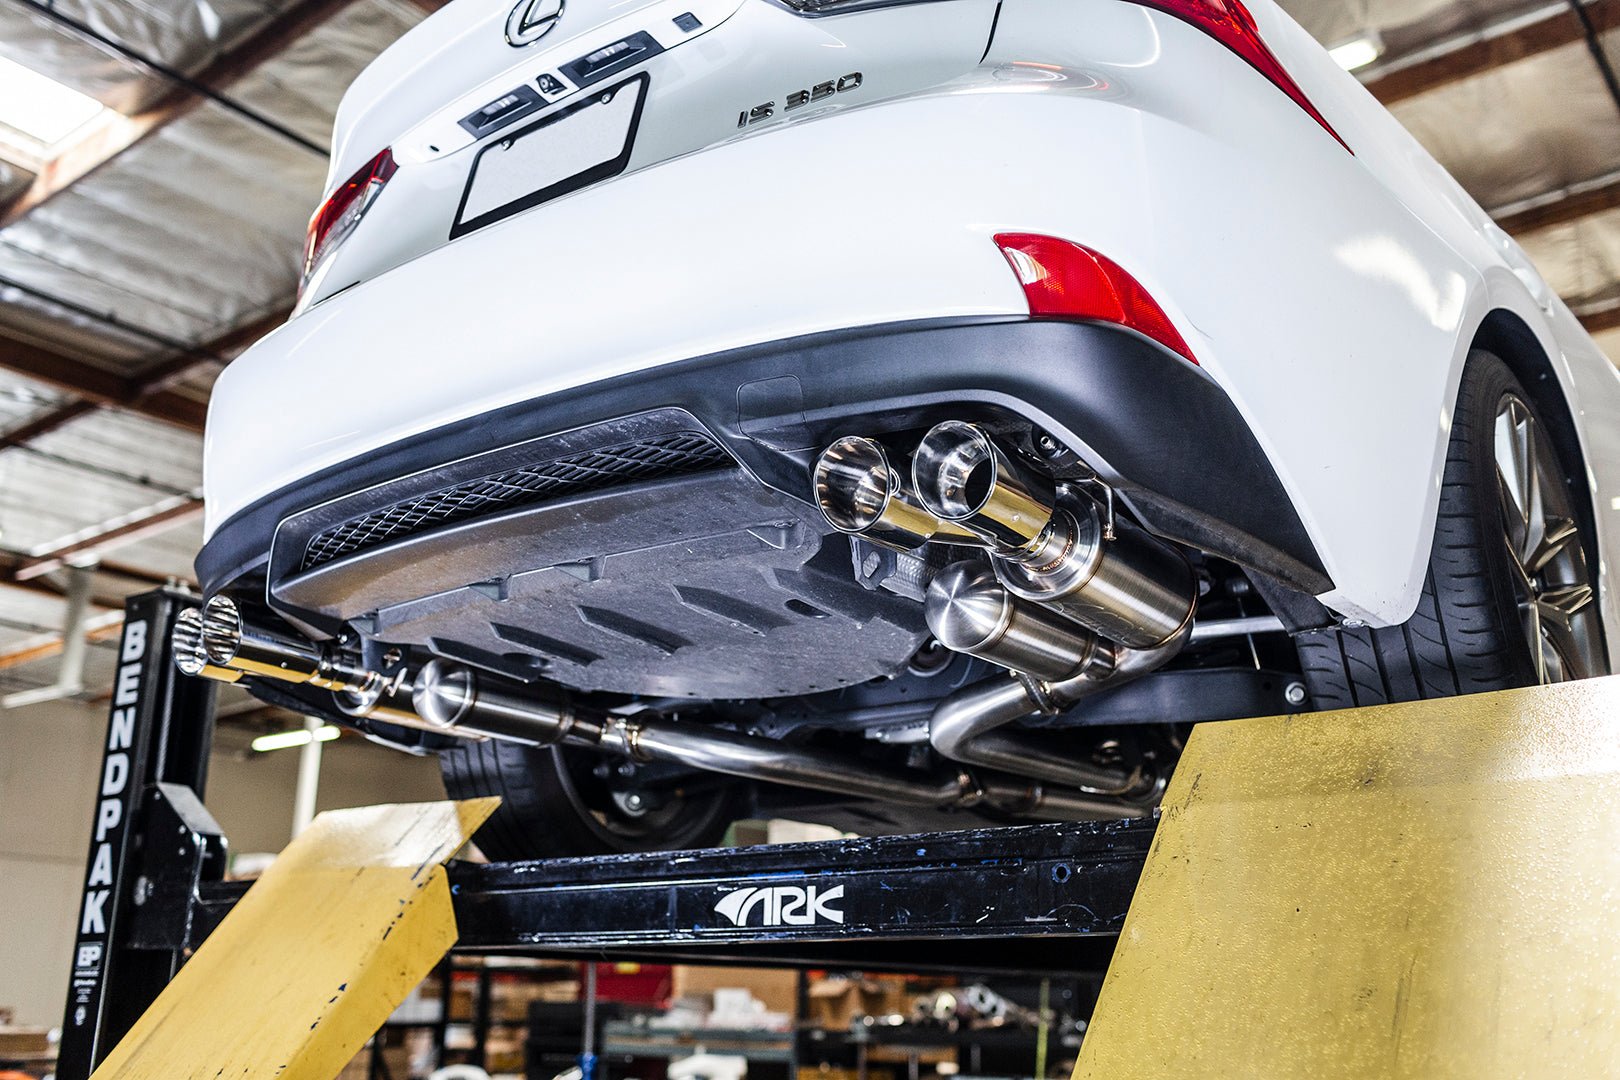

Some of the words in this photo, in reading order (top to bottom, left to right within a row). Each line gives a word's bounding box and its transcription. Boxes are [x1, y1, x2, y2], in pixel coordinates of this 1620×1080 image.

[737, 100, 775, 128] IS
[784, 71, 863, 112] 350
[81, 619, 147, 934] BENDPAK
[714, 884, 844, 926] ARK
